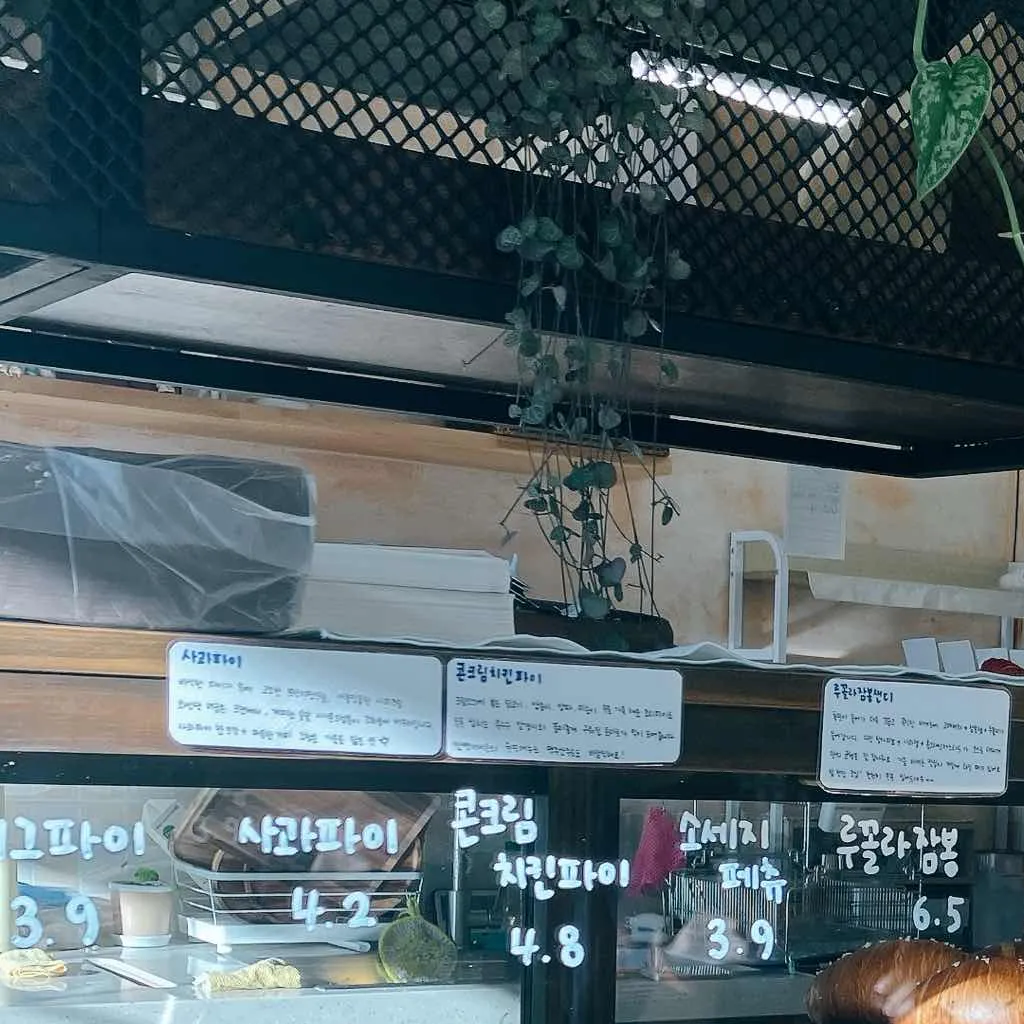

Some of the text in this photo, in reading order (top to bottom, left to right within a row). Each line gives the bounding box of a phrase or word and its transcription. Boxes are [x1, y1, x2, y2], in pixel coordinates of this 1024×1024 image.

[181, 649, 242, 669] 사과파이
[456, 662, 542, 685] 콘크림치킨파이
[238, 814, 398, 857] 사과파이
[451, 788, 538, 849] 콘크림
[680, 811, 770, 851] 소세지
[836, 814, 959, 878] 루꼴라잠봉
[493, 852, 631, 900] 치킨파이
[10, 895, 100, 949] 3.9
[292, 887, 378, 932] 4.2
[912, 895, 965, 933] 6.5
[510, 924, 585, 968] 4.8
[707, 918, 774, 960] 3.9
